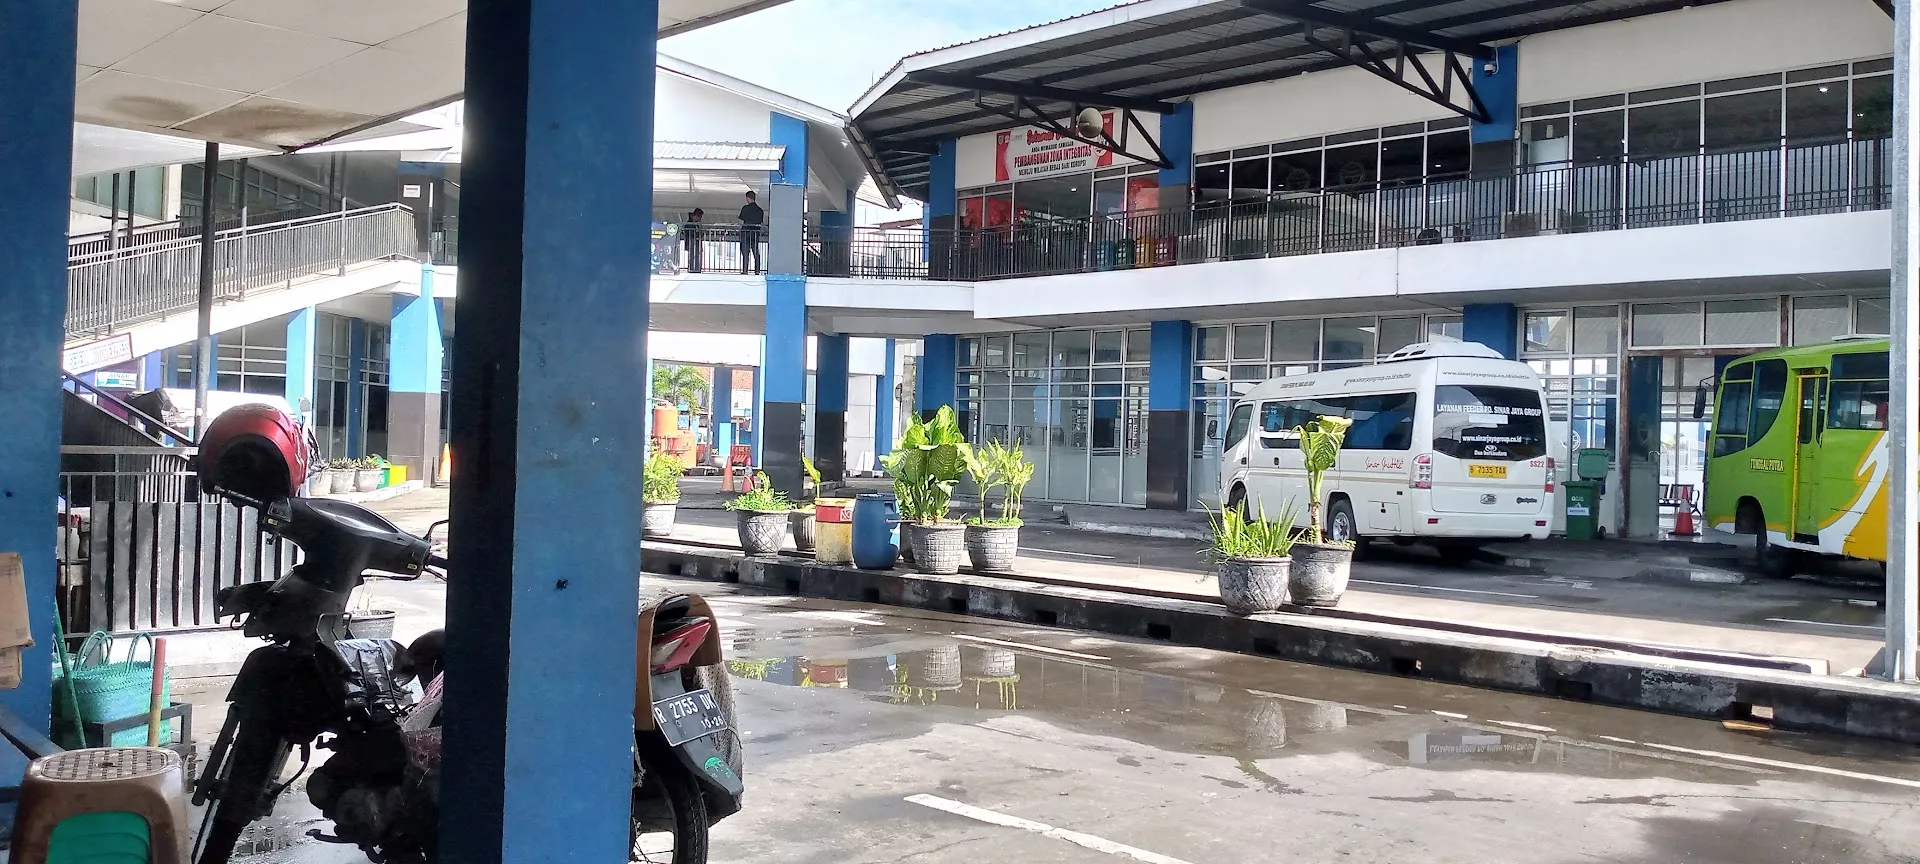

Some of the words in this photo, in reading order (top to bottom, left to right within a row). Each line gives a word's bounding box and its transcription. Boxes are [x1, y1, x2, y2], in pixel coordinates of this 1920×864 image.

[1014, 152, 1049, 168] PEMBANGUNAN
[1049, 149, 1063, 162] ZONA
[1062, 145, 1092, 161] INTEGRITAS
[1018, 168, 1033, 176] MENUJU
[1033, 165, 1049, 174] WILAYAH
[1049, 163, 1061, 171] BEBAS
[1061, 161, 1070, 170] DARI
[1070, 160, 1087, 168] KORUPSI
[1436, 404, 1462, 413] LAYANAN
[1463, 405, 1485, 413] FEEDER
[1494, 406, 1510, 415] SINAR
[1511, 407, 1523, 415] JAYA
[1524, 407, 1541, 417] GROUP
[1462, 434, 1522, 444] www.sinarjayagroup.co.id
[1477, 466, 1493, 474] 7135
[1529, 460, 1545, 468] SS22
[654, 707, 668, 724] R
[669, 697, 699, 719] 2755
[699, 693, 716, 710] DK
